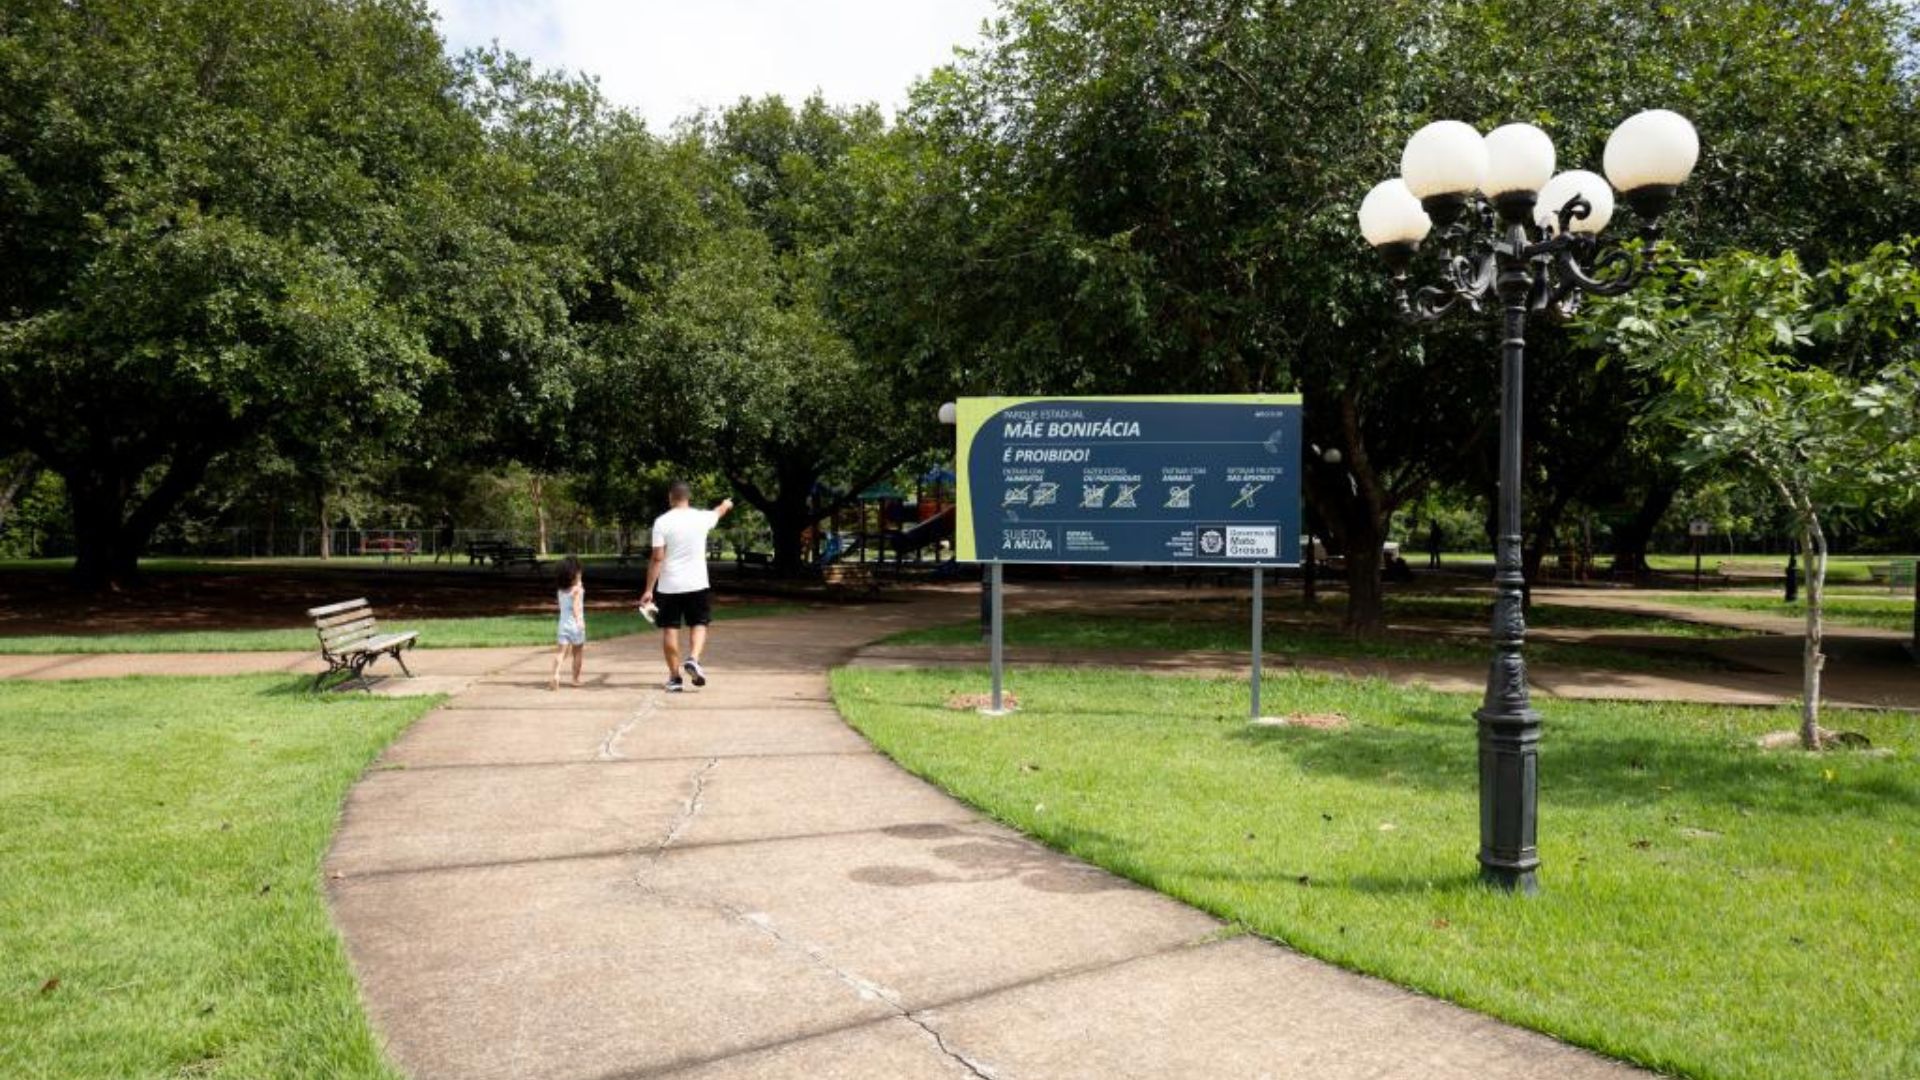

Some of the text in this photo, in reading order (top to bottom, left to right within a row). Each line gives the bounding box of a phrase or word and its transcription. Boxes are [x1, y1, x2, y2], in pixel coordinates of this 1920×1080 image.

[1003, 409, 1083, 420] PARQUE ESTADUAL
[1003, 418, 1140, 438] MÃE BONIFÁCIA
[1003, 447, 1090, 463] É PROIBIDO!
[1003, 529, 1046, 540] SUJEITO
[1014, 540, 1052, 550] MULTA
[1230, 537, 1256, 545] Mato
[1230, 546, 1268, 554] Grosso
